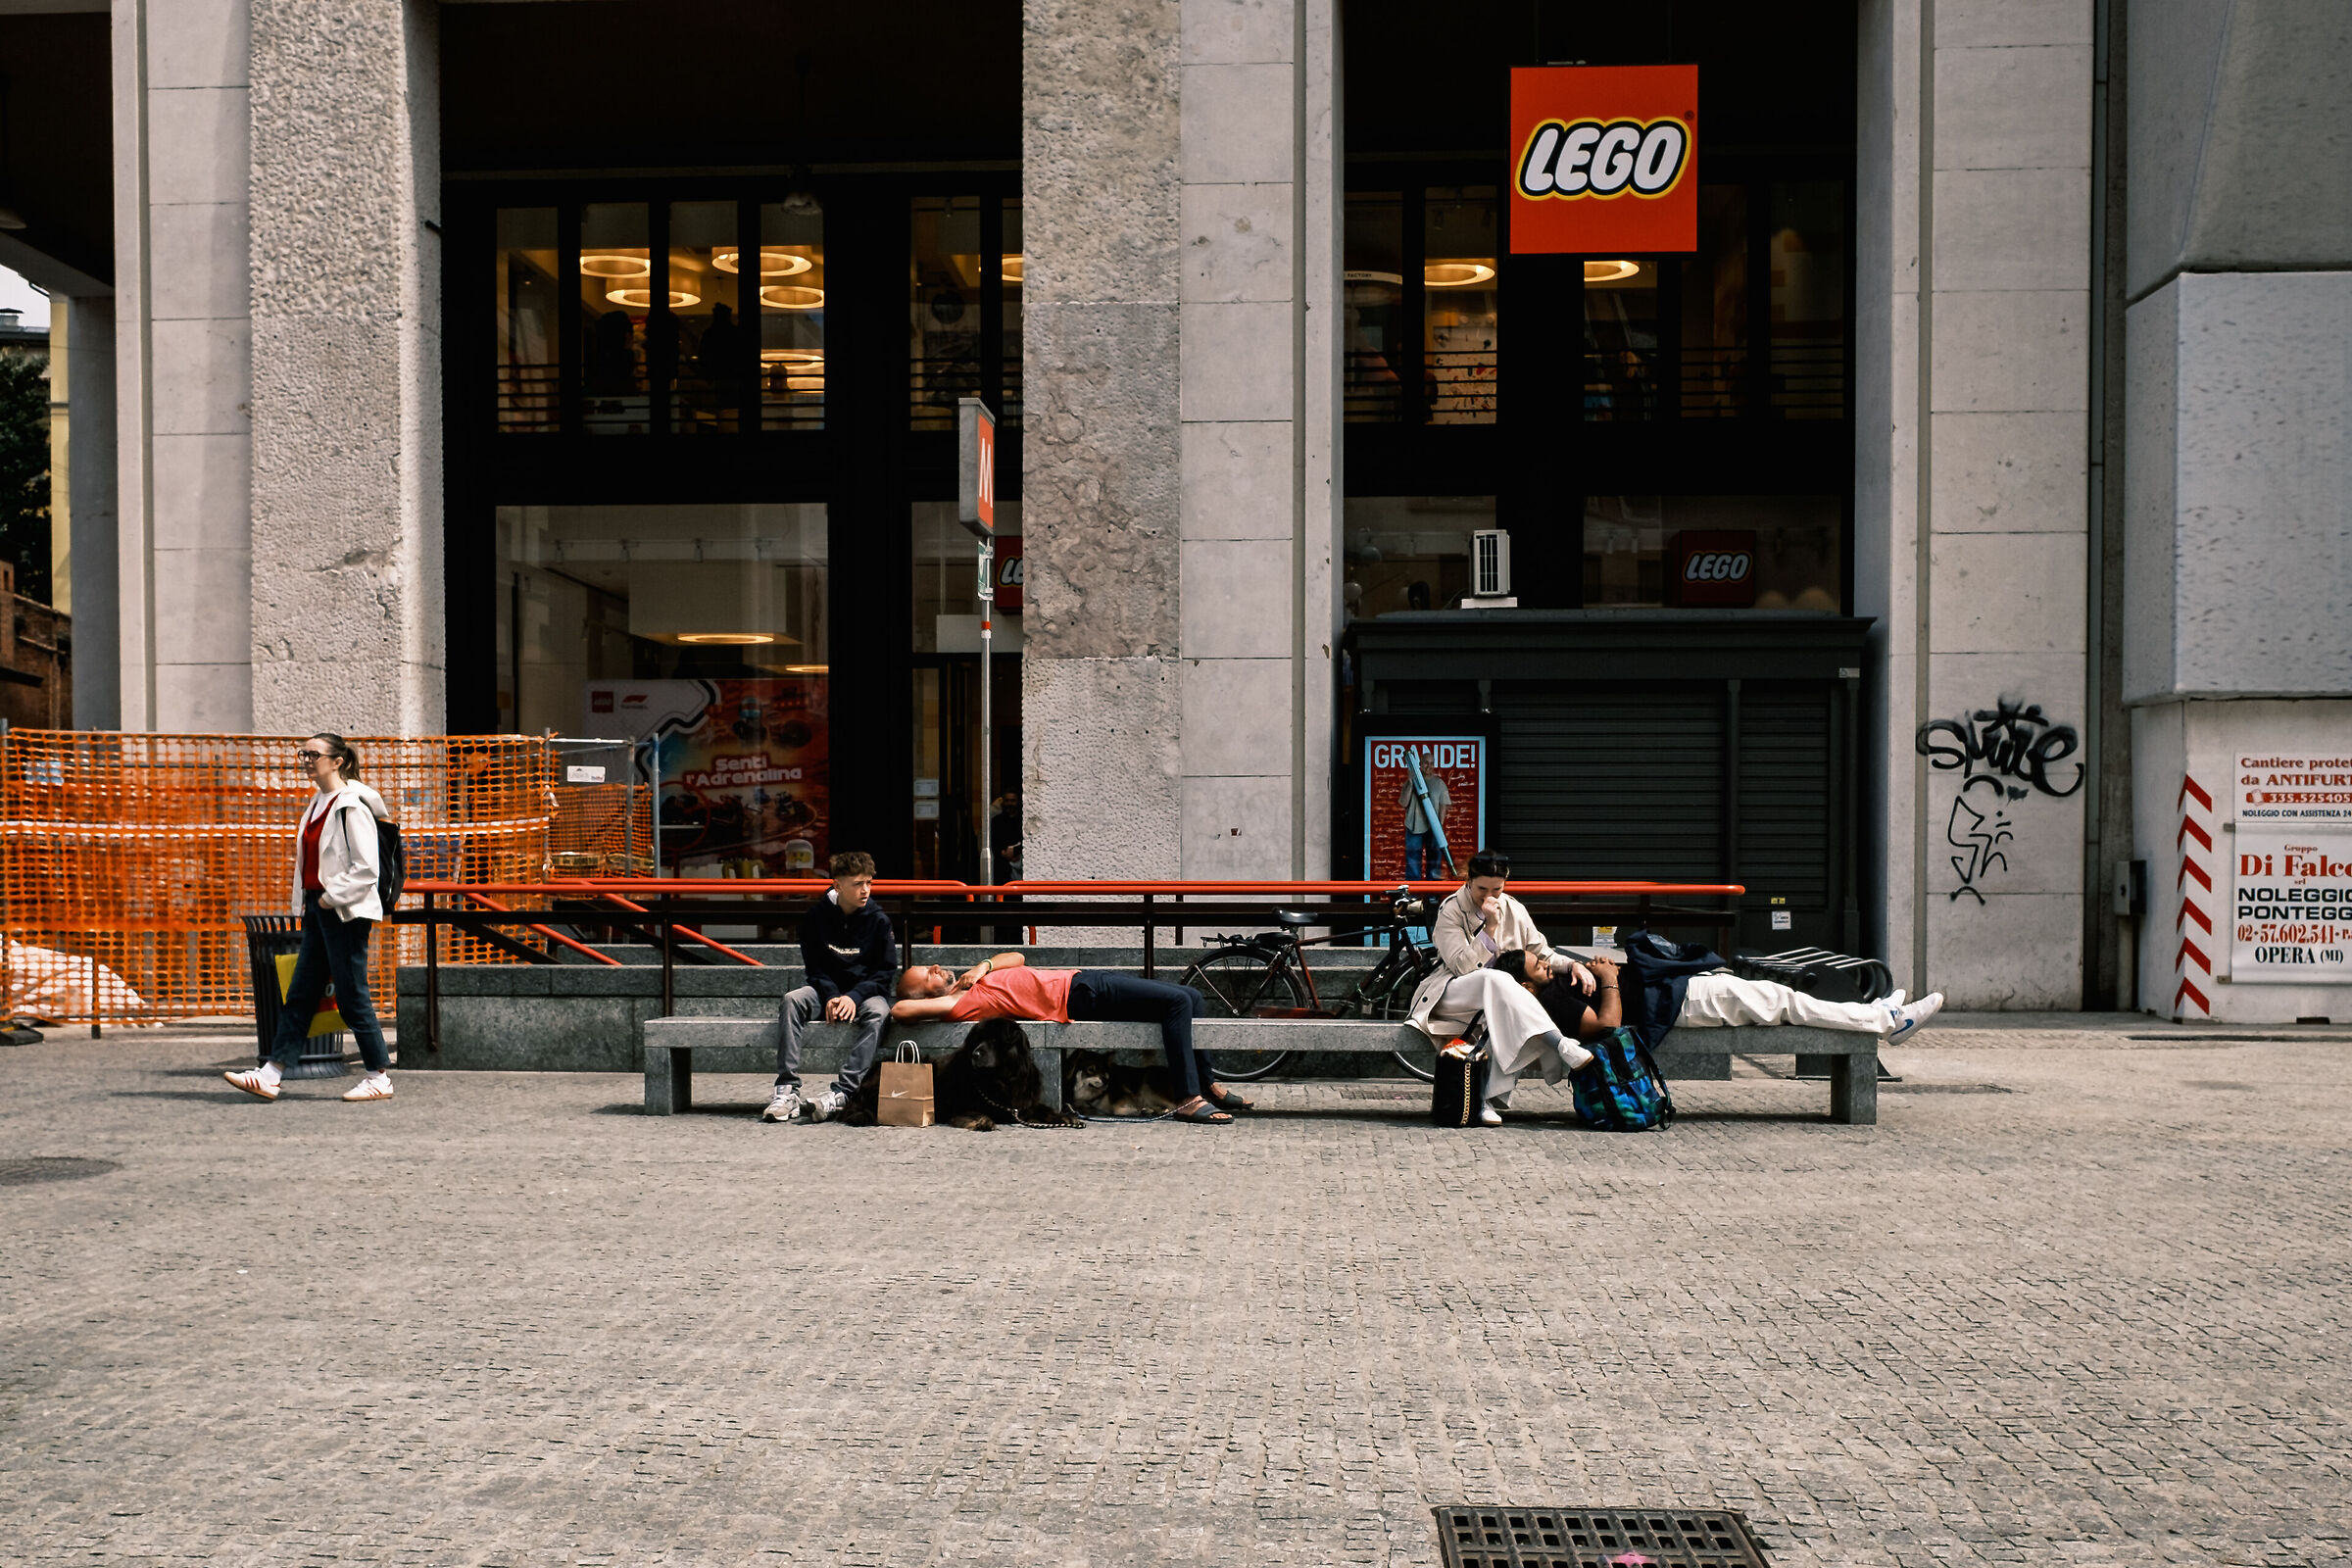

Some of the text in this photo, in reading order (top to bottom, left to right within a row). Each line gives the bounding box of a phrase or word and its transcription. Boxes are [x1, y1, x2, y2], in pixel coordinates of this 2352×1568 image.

[1520, 122, 1687, 196] LEGO
[978, 437, 994, 509] M
[1685, 553, 1750, 581] LEGO
[715, 756, 767, 772] Senti
[2240, 757, 2304, 768] Cantiere
[2240, 774, 2260, 785] da
[2283, 844, 2319, 854] Gruppo
[2239, 854, 2273, 877] Di
[2237, 906, 2352, 920] PONTEGG
[2255, 946, 2343, 964] OPERA (MI)
